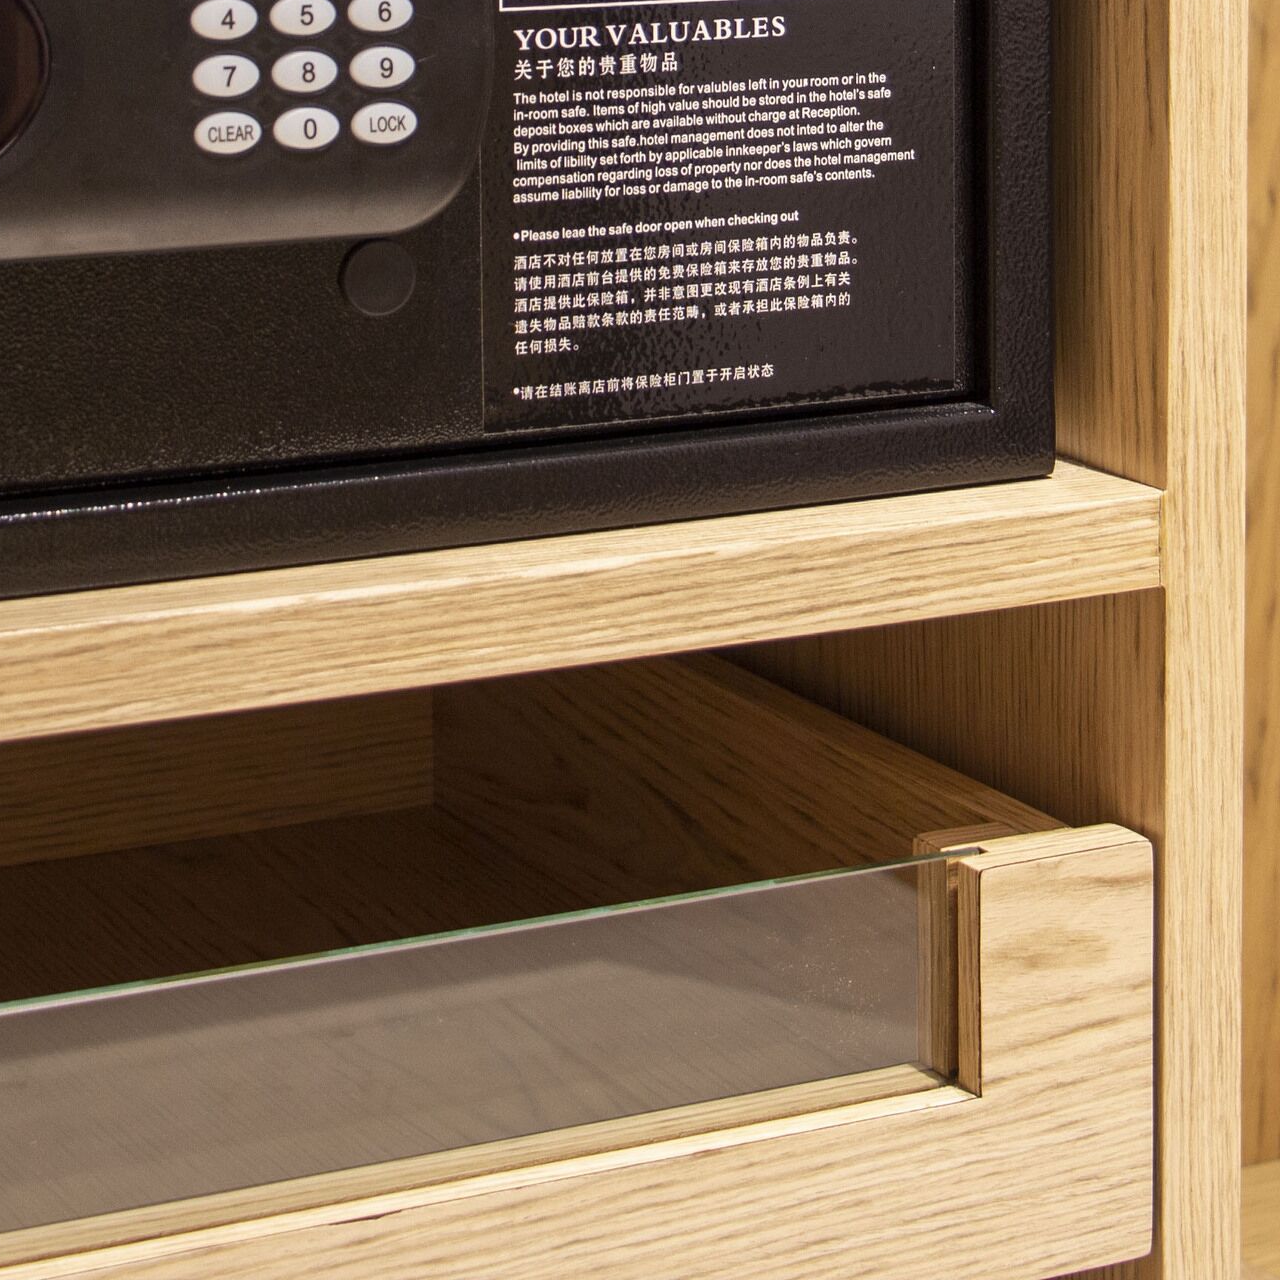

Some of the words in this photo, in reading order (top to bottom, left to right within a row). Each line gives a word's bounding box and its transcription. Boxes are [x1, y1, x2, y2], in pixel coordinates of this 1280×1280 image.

[221, 8, 236, 30] 4
[300, 4, 314, 26] 5
[378, 1, 392, 22] 6
[513, 26, 602, 51] YOUR
[605, 16, 786, 46] VALUABLES
[223, 66, 236, 87] 7
[302, 62, 316, 83] 8
[380, 57, 394, 78] 9
[514, 52, 678, 80] 关于您的贵重物品
[512, 92, 536, 104] The
[539, 90, 569, 103] hotel
[572, 89, 582, 101] is
[584, 88, 604, 100] not
[606, 83, 676, 100] responsible
[678, 82, 695, 95] for
[748, 77, 767, 90] left
[768, 77, 779, 90] in
[810, 76, 839, 87] room
[841, 75, 854, 85] or
[855, 72, 866, 84] in
[868, 71, 886, 83] the
[513, 109, 558, 121] in-room
[560, 104, 589, 118] safe.
[593, 104, 625, 116] Items
[627, 101, 639, 114] of
[640, 100, 666, 115] high
[668, 98, 699, 111] value
[701, 95, 739, 109] should
[742, 95, 756, 107] be
[758, 92, 794, 106] stored
[796, 91, 806, 103] in
[808, 90, 827, 102] the
[828, 88, 865, 101] hotel's
[867, 86, 891, 99] safe
[208, 125, 254, 143] CLEAR
[303, 118, 317, 140] 0
[370, 115, 406, 133] LOCK
[513, 123, 556, 139] deposit
[558, 122, 593, 134] boxes
[595, 118, 629, 132] which
[630, 119, 650, 130] are
[652, 113, 703, 128] available
[705, 111, 746, 125] without
[747, 110, 787, 123] charge
[788, 108, 800, 120] at
[801, 104, 860, 119] Reception.
[513, 141, 529, 156] By
[531, 138, 585, 155] providing
[587, 136, 609, 149] this
[670, 128, 745, 144] management
[746, 126, 775, 139] does
[776, 124, 795, 137] not
[796, 122, 824, 135] inted
[826, 122, 837, 134] to
[839, 120, 864, 133] alter
[865, 119, 884, 131] the
[512, 171, 595, 188] compensation
[597, 167, 652, 183] regarding
[654, 166, 678, 177] loss
[680, 162, 692, 176] of
[694, 160, 741, 177] property
[743, 160, 762, 171] nor
[764, 157, 792, 170] does
[793, 155, 812, 168] the
[813, 152, 841, 166] hotel
[843, 148, 915, 165] management
[516, 158, 548, 170] limits
[549, 156, 562, 168] of
[564, 154, 597, 168] libility
[599, 153, 618, 165] set
[619, 150, 646, 164] forth
[648, 150, 663, 164] by
[664, 146, 723, 163] applicable
[792, 140, 818, 152] laws
[819, 137, 852, 150] which
[854, 136, 892, 151] govern
[512, 191, 559, 203] assume
[561, 186, 602, 200] liability
[604, 184, 621, 197] for
[622, 184, 646, 195] loss
[648, 183, 661, 194] or
[662, 180, 709, 193] damage
[710, 178, 722, 189] to
[724, 176, 743, 188] the
[744, 174, 788, 186] in-room
[789, 170, 823, 184] safe's
[824, 167, 875, 181] contents.
[587, 224, 606, 237] the
[608, 222, 633, 235] safe
[634, 221, 662, 233] door
[663, 220, 692, 233] open
[694, 216, 725, 228] when
[727, 212, 778, 226] checking
[780, 210, 799, 222] out
[515, 336, 580, 356] 任何损失。
